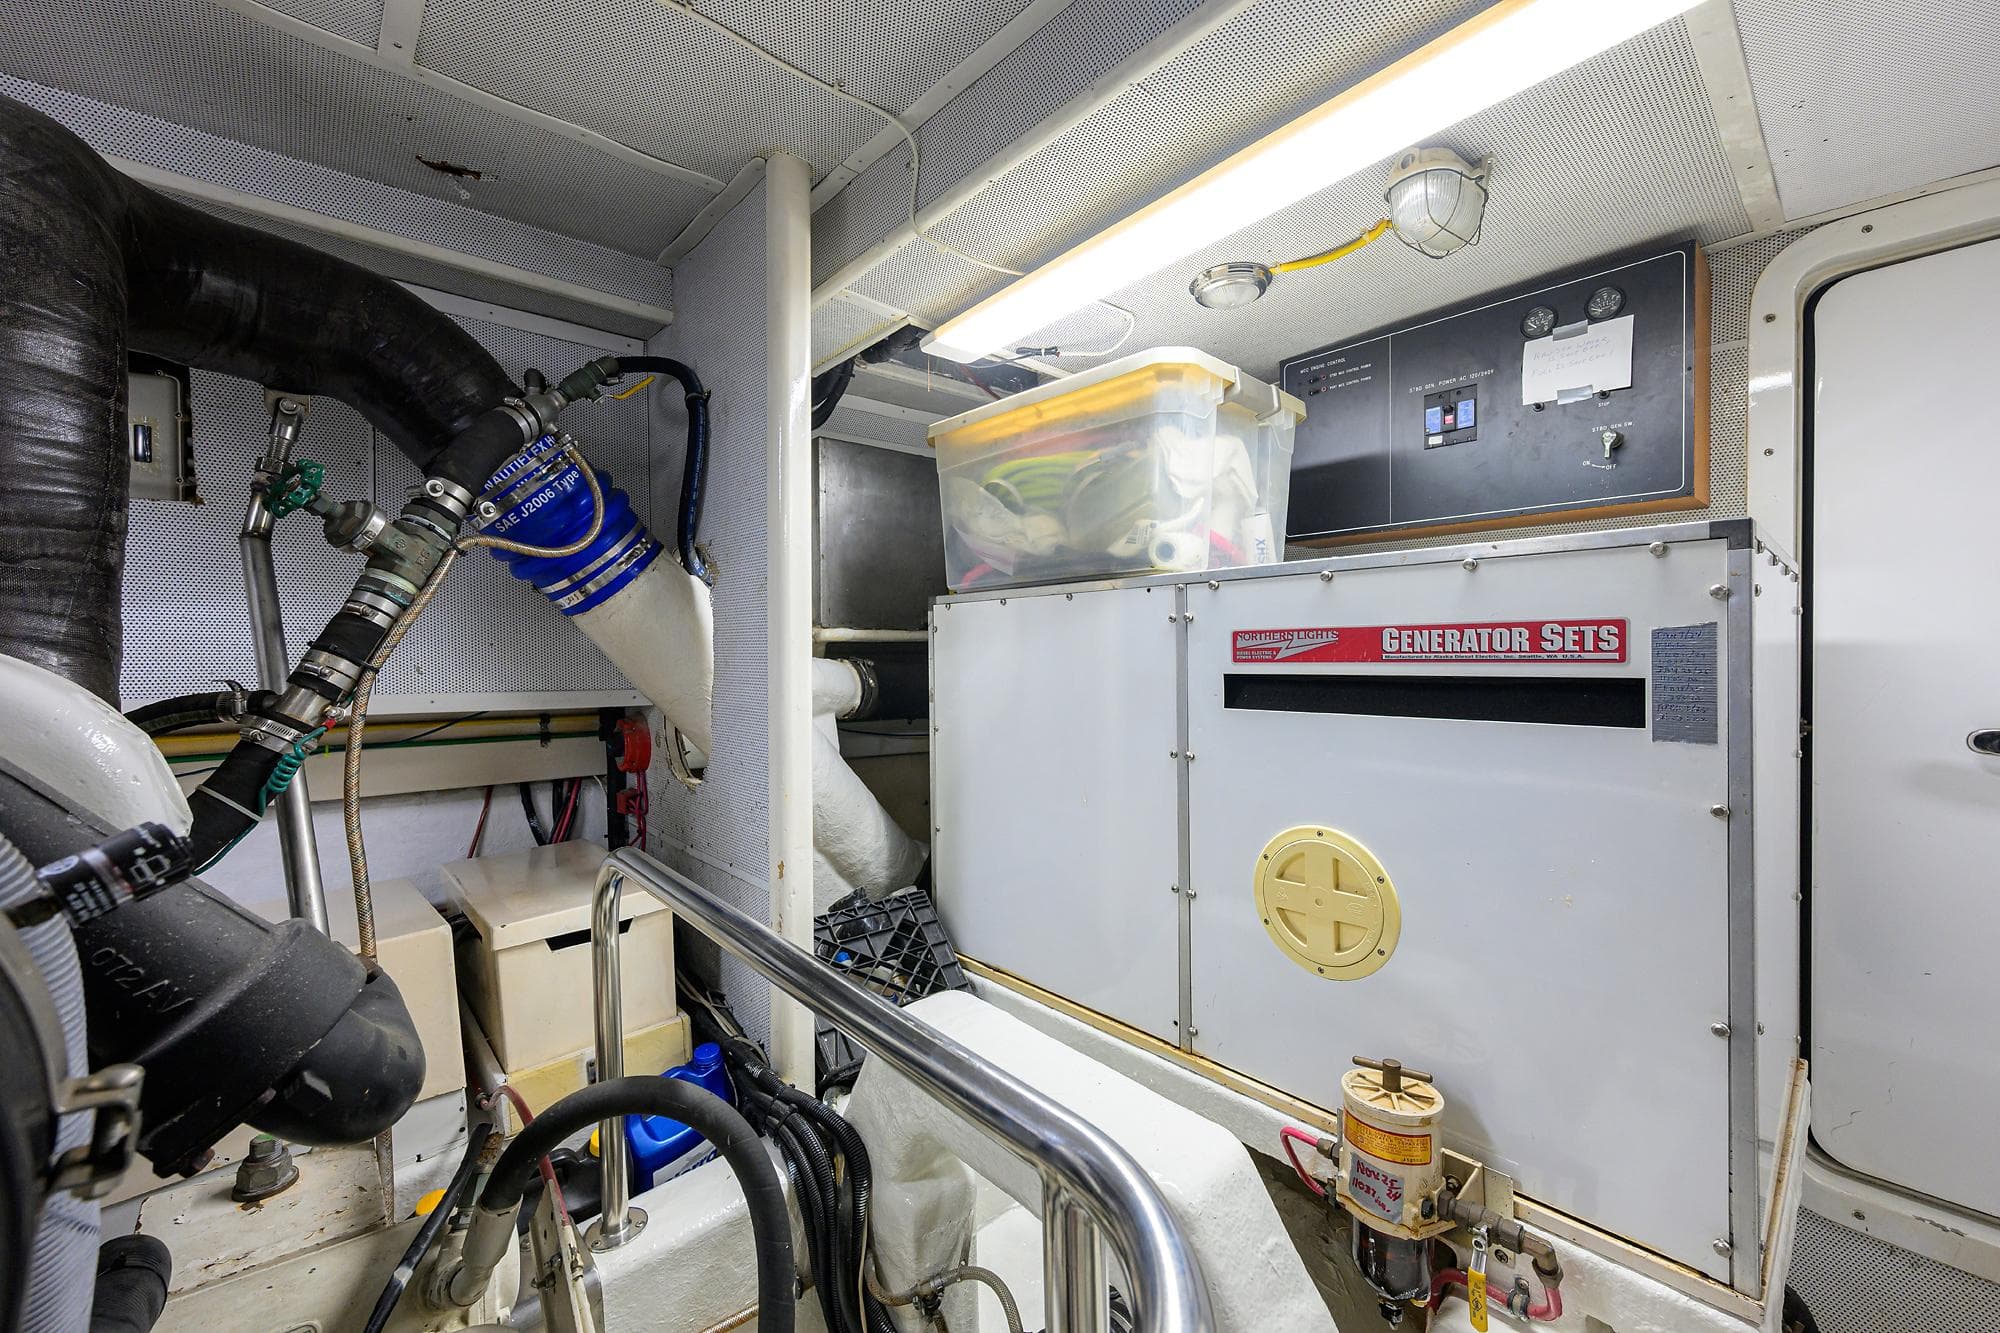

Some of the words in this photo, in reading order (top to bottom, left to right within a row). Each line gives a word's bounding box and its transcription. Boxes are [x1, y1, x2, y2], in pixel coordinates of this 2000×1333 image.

[1438, 377, 1457, 386] POWER
[484, 440, 548, 491] NAUTIFLEX
[495, 512, 521, 533] SAE
[521, 488, 556, 517] J2006
[552, 469, 580, 494] Type
[1238, 632, 1294, 641] NORTHERN
[1297, 630, 1339, 641] LIGHTS
